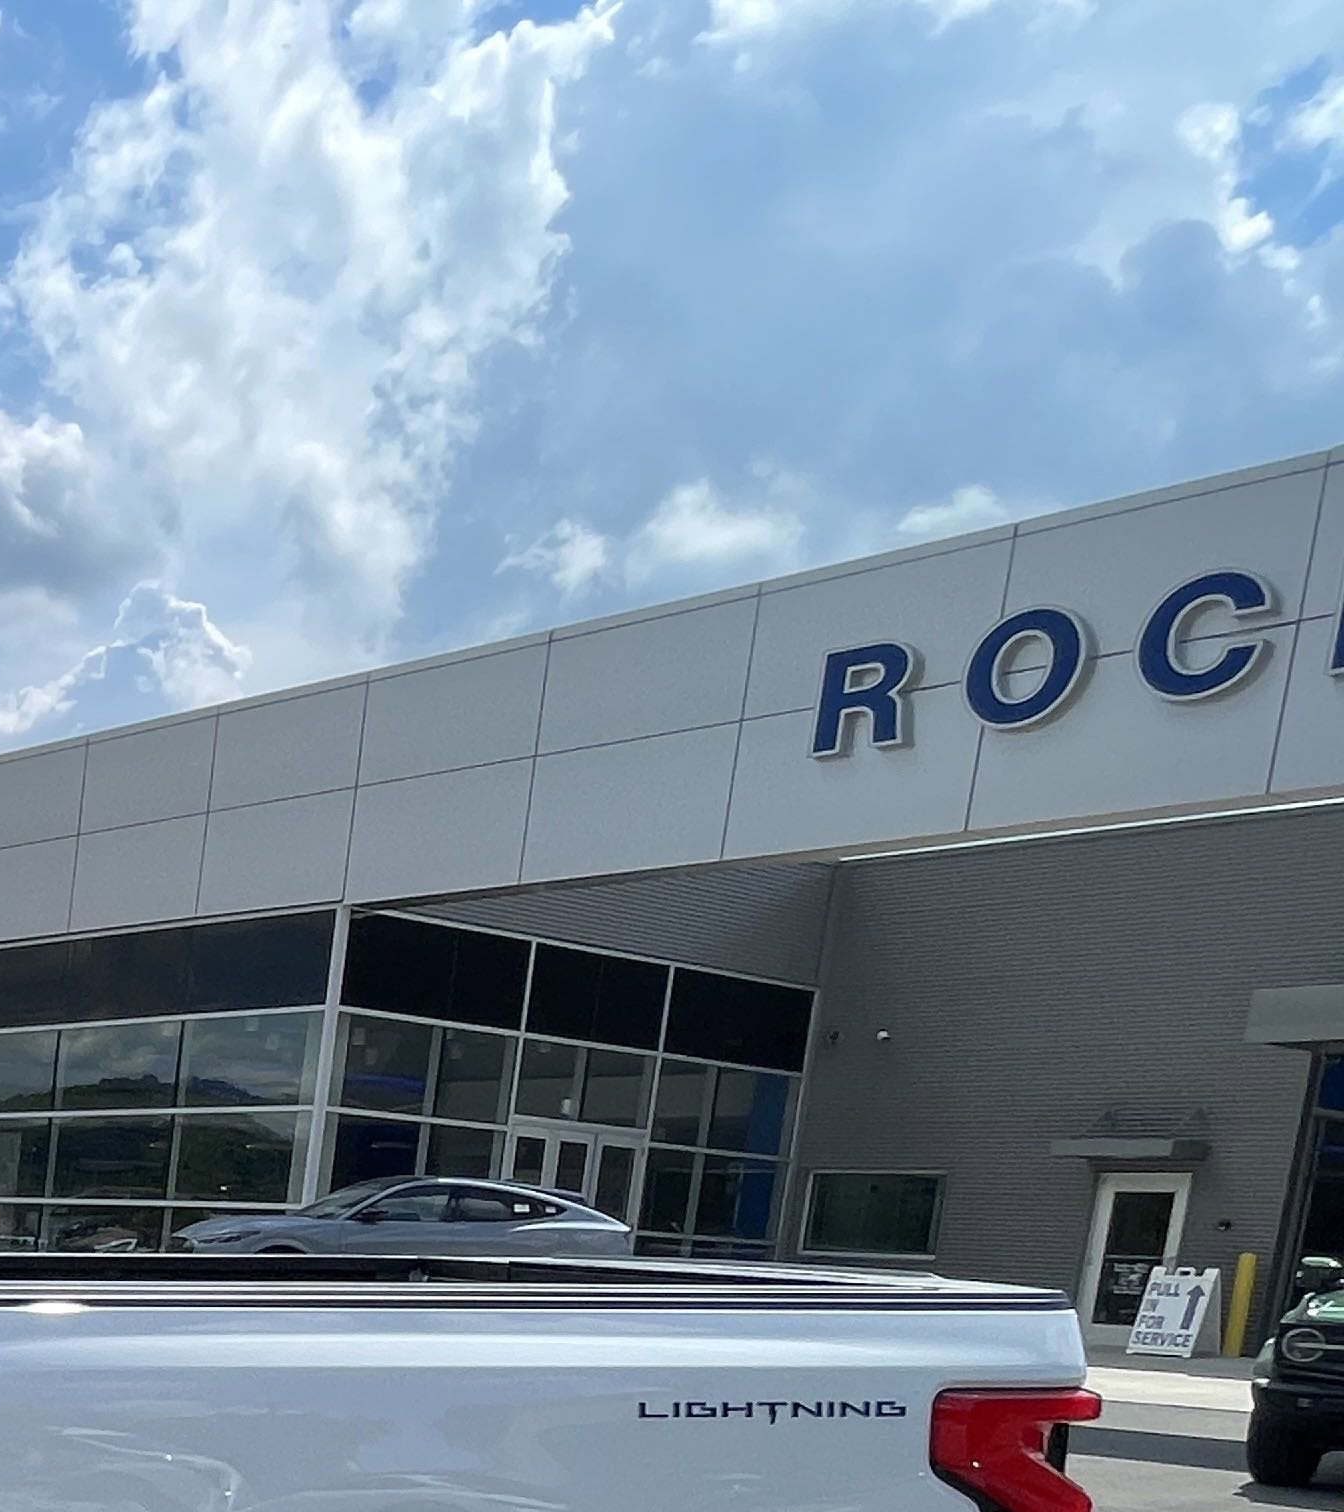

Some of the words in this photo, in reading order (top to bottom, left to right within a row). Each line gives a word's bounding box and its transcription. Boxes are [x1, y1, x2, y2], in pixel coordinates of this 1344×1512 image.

[810, 569, 1344, 757] ROC
[1148, 1281, 1180, 1297] PULL
[1132, 1331, 1193, 1348] SERVICE
[638, 1401, 907, 1424] LIGHTNING
